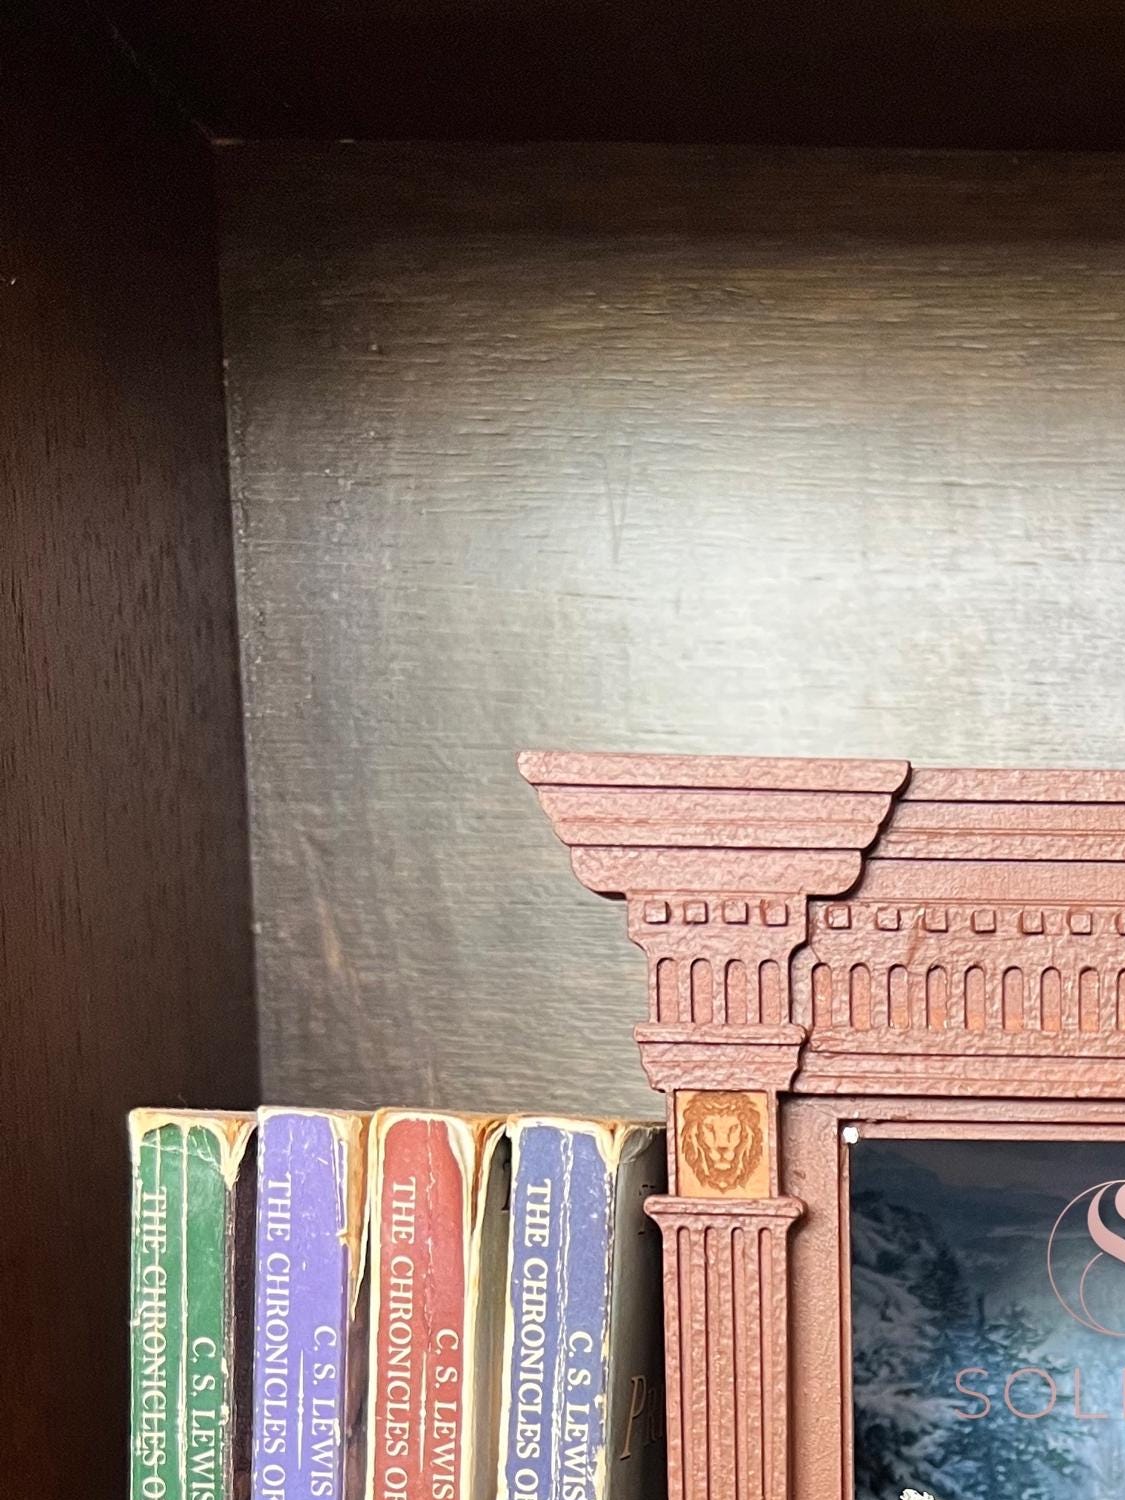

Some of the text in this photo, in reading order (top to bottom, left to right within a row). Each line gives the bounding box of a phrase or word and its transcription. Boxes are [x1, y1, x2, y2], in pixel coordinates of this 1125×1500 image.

[142, 1187, 167, 1253] THE
[267, 1175, 291, 1241] THE
[390, 1177, 415, 1244] THE
[525, 1179, 551, 1247] THE
[141, 1265, 167, 1467] CHRONICLES
[191, 1336, 216, 1363] C.
[262, 1254, 290, 1456] CHRONICLES
[385, 1256, 414, 1457] CHRONICLES
[516, 1258, 548, 1460] CHRONICLES
[568, 1331, 592, 1358] C.
[192, 1372, 216, 1397] S.
[310, 1326, 337, 1497] C. S. LEWIS
[566, 1368, 591, 1392] S.
[431, 1329, 459, 1500] C. S. LEWIS
